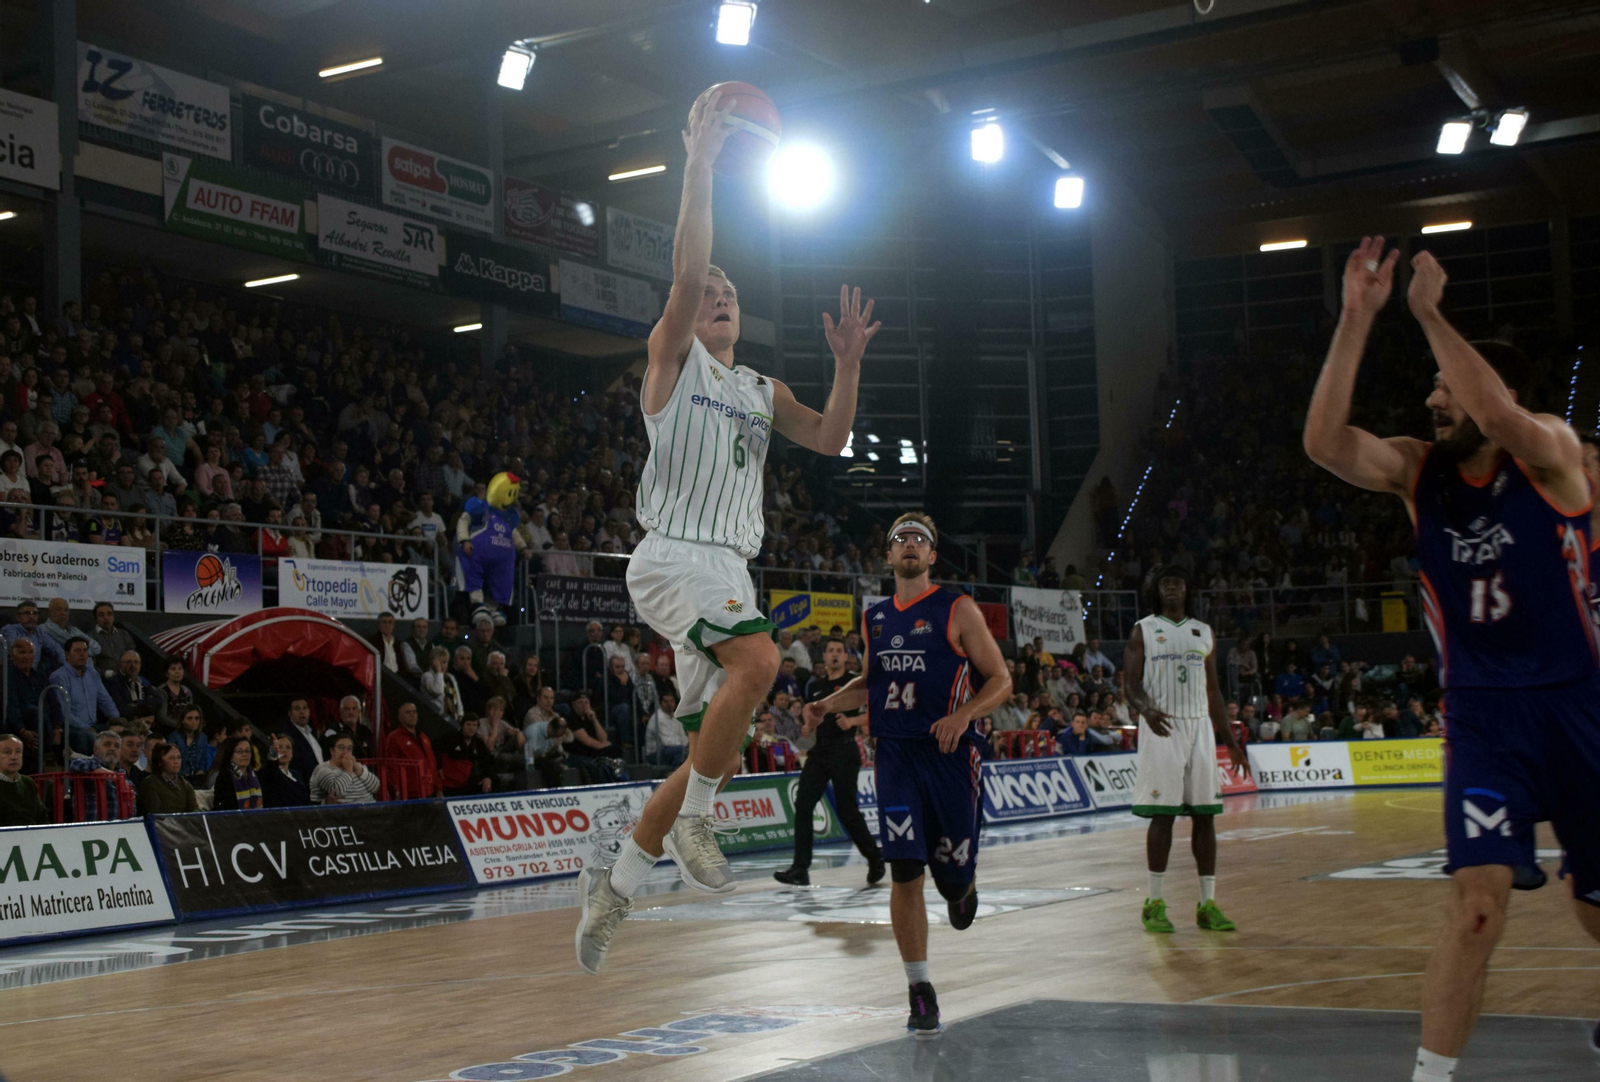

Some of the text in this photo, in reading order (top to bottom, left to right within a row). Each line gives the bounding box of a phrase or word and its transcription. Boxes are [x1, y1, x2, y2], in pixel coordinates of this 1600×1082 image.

[142, 91, 227, 131] FERRETEROS
[259, 105, 358, 154] Cobarsa
[393, 157, 431, 179] satpa
[193, 187, 296, 228] AUTO FFAM
[346, 210, 388, 236] Seguros
[371, 241, 412, 263] Revilla
[479, 257, 545, 293] Kappa
[733, 434, 746, 469] 6
[32, 555, 39, 566] y
[41, 552, 99, 567] Cuadernos
[107, 556, 140, 574] Sam
[4, 569, 88, 581] Fabricados en Palencia
[566, 581, 578, 591] BAR
[583, 582, 623, 594] RESTAURANTE
[1470, 571, 1512, 624] 15
[306, 595, 358, 610] Calle Mayor
[568, 593, 579, 609] de
[1176, 665, 1187, 683] 3
[884, 681, 917, 711] 24
[1099, 758, 1138, 791] lam
[453, 800, 508, 816] DESGUACE
[511, 799, 524, 811] DE
[528, 796, 580, 810] VEHICULOS
[732, 797, 776, 820] FFAM
[299, 825, 364, 850] HOTEL
[458, 809, 590, 844] MUNDO
[308, 844, 458, 877] CASTILLA VIEJA
[470, 844, 511, 857] ASISTENCIA
[511, 841, 533, 853] GRUA
[533, 841, 546, 850] 24H
[506, 850, 543, 862] Santander
[934, 834, 972, 867] 24
[483, 857, 583, 880] 979 702 370
[30, 890, 94, 917] Matricera
[97, 884, 154, 910] Palentina
